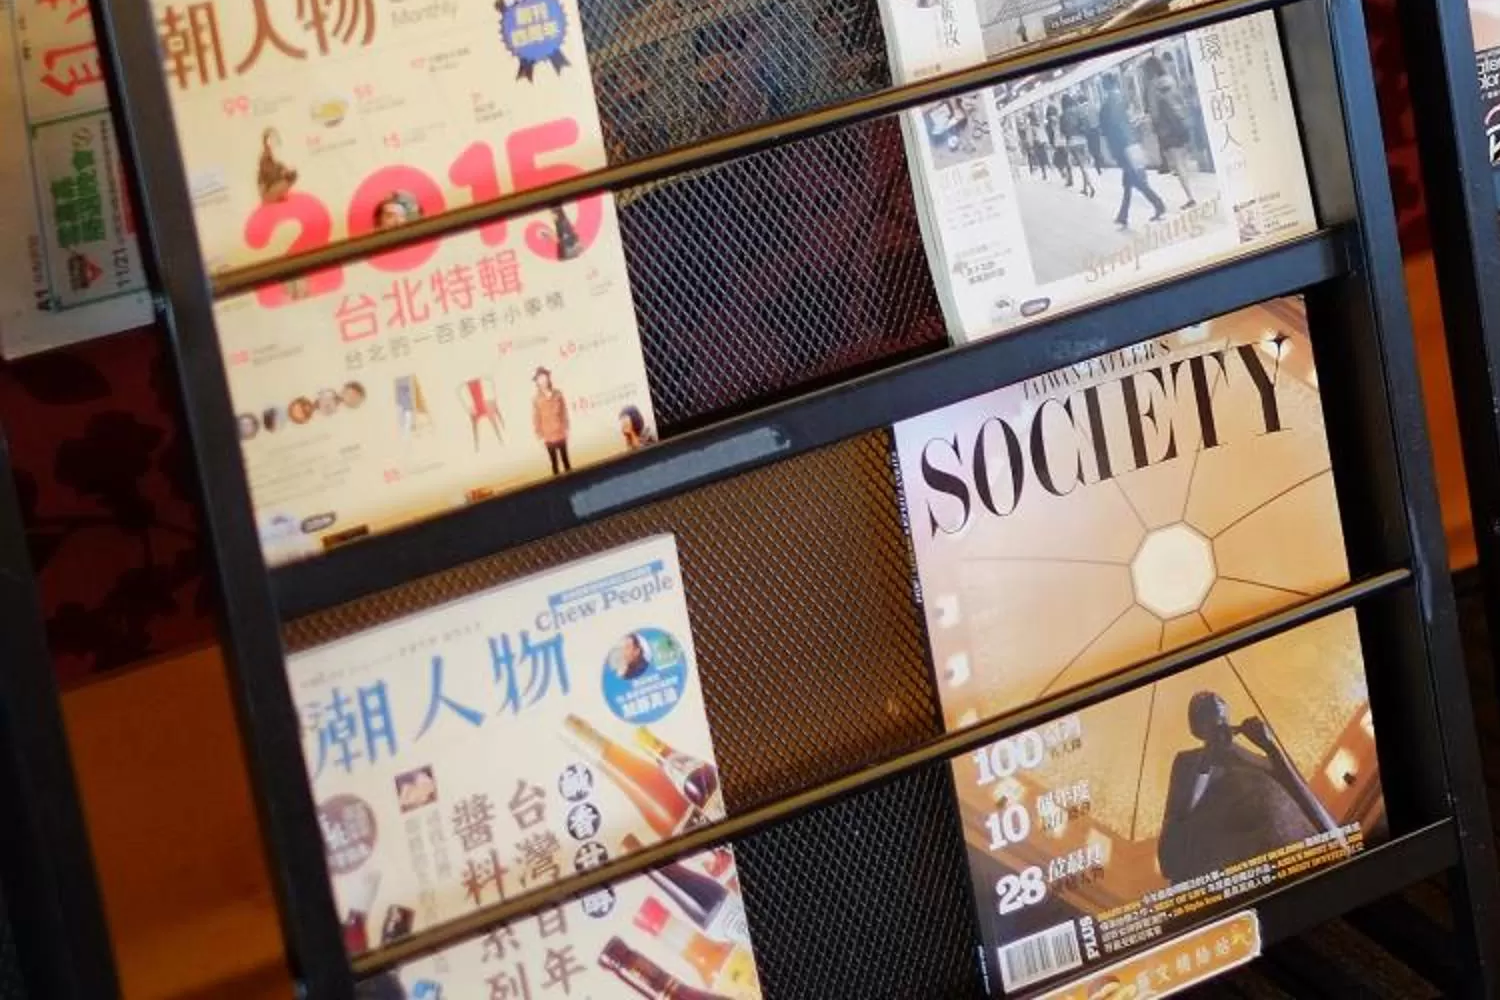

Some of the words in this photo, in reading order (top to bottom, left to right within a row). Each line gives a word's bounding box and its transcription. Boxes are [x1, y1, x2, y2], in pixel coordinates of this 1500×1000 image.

[244, 116, 605, 309] 2015
[333, 248, 524, 343] 台北特輯
[920, 336, 1294, 539] SOCIETY
[304, 628, 573, 781] 潮人物
[972, 730, 1044, 787] 100
[985, 803, 1032, 851] 10
[995, 865, 1048, 916] 28
[1079, 915, 1101, 961] PLUS
